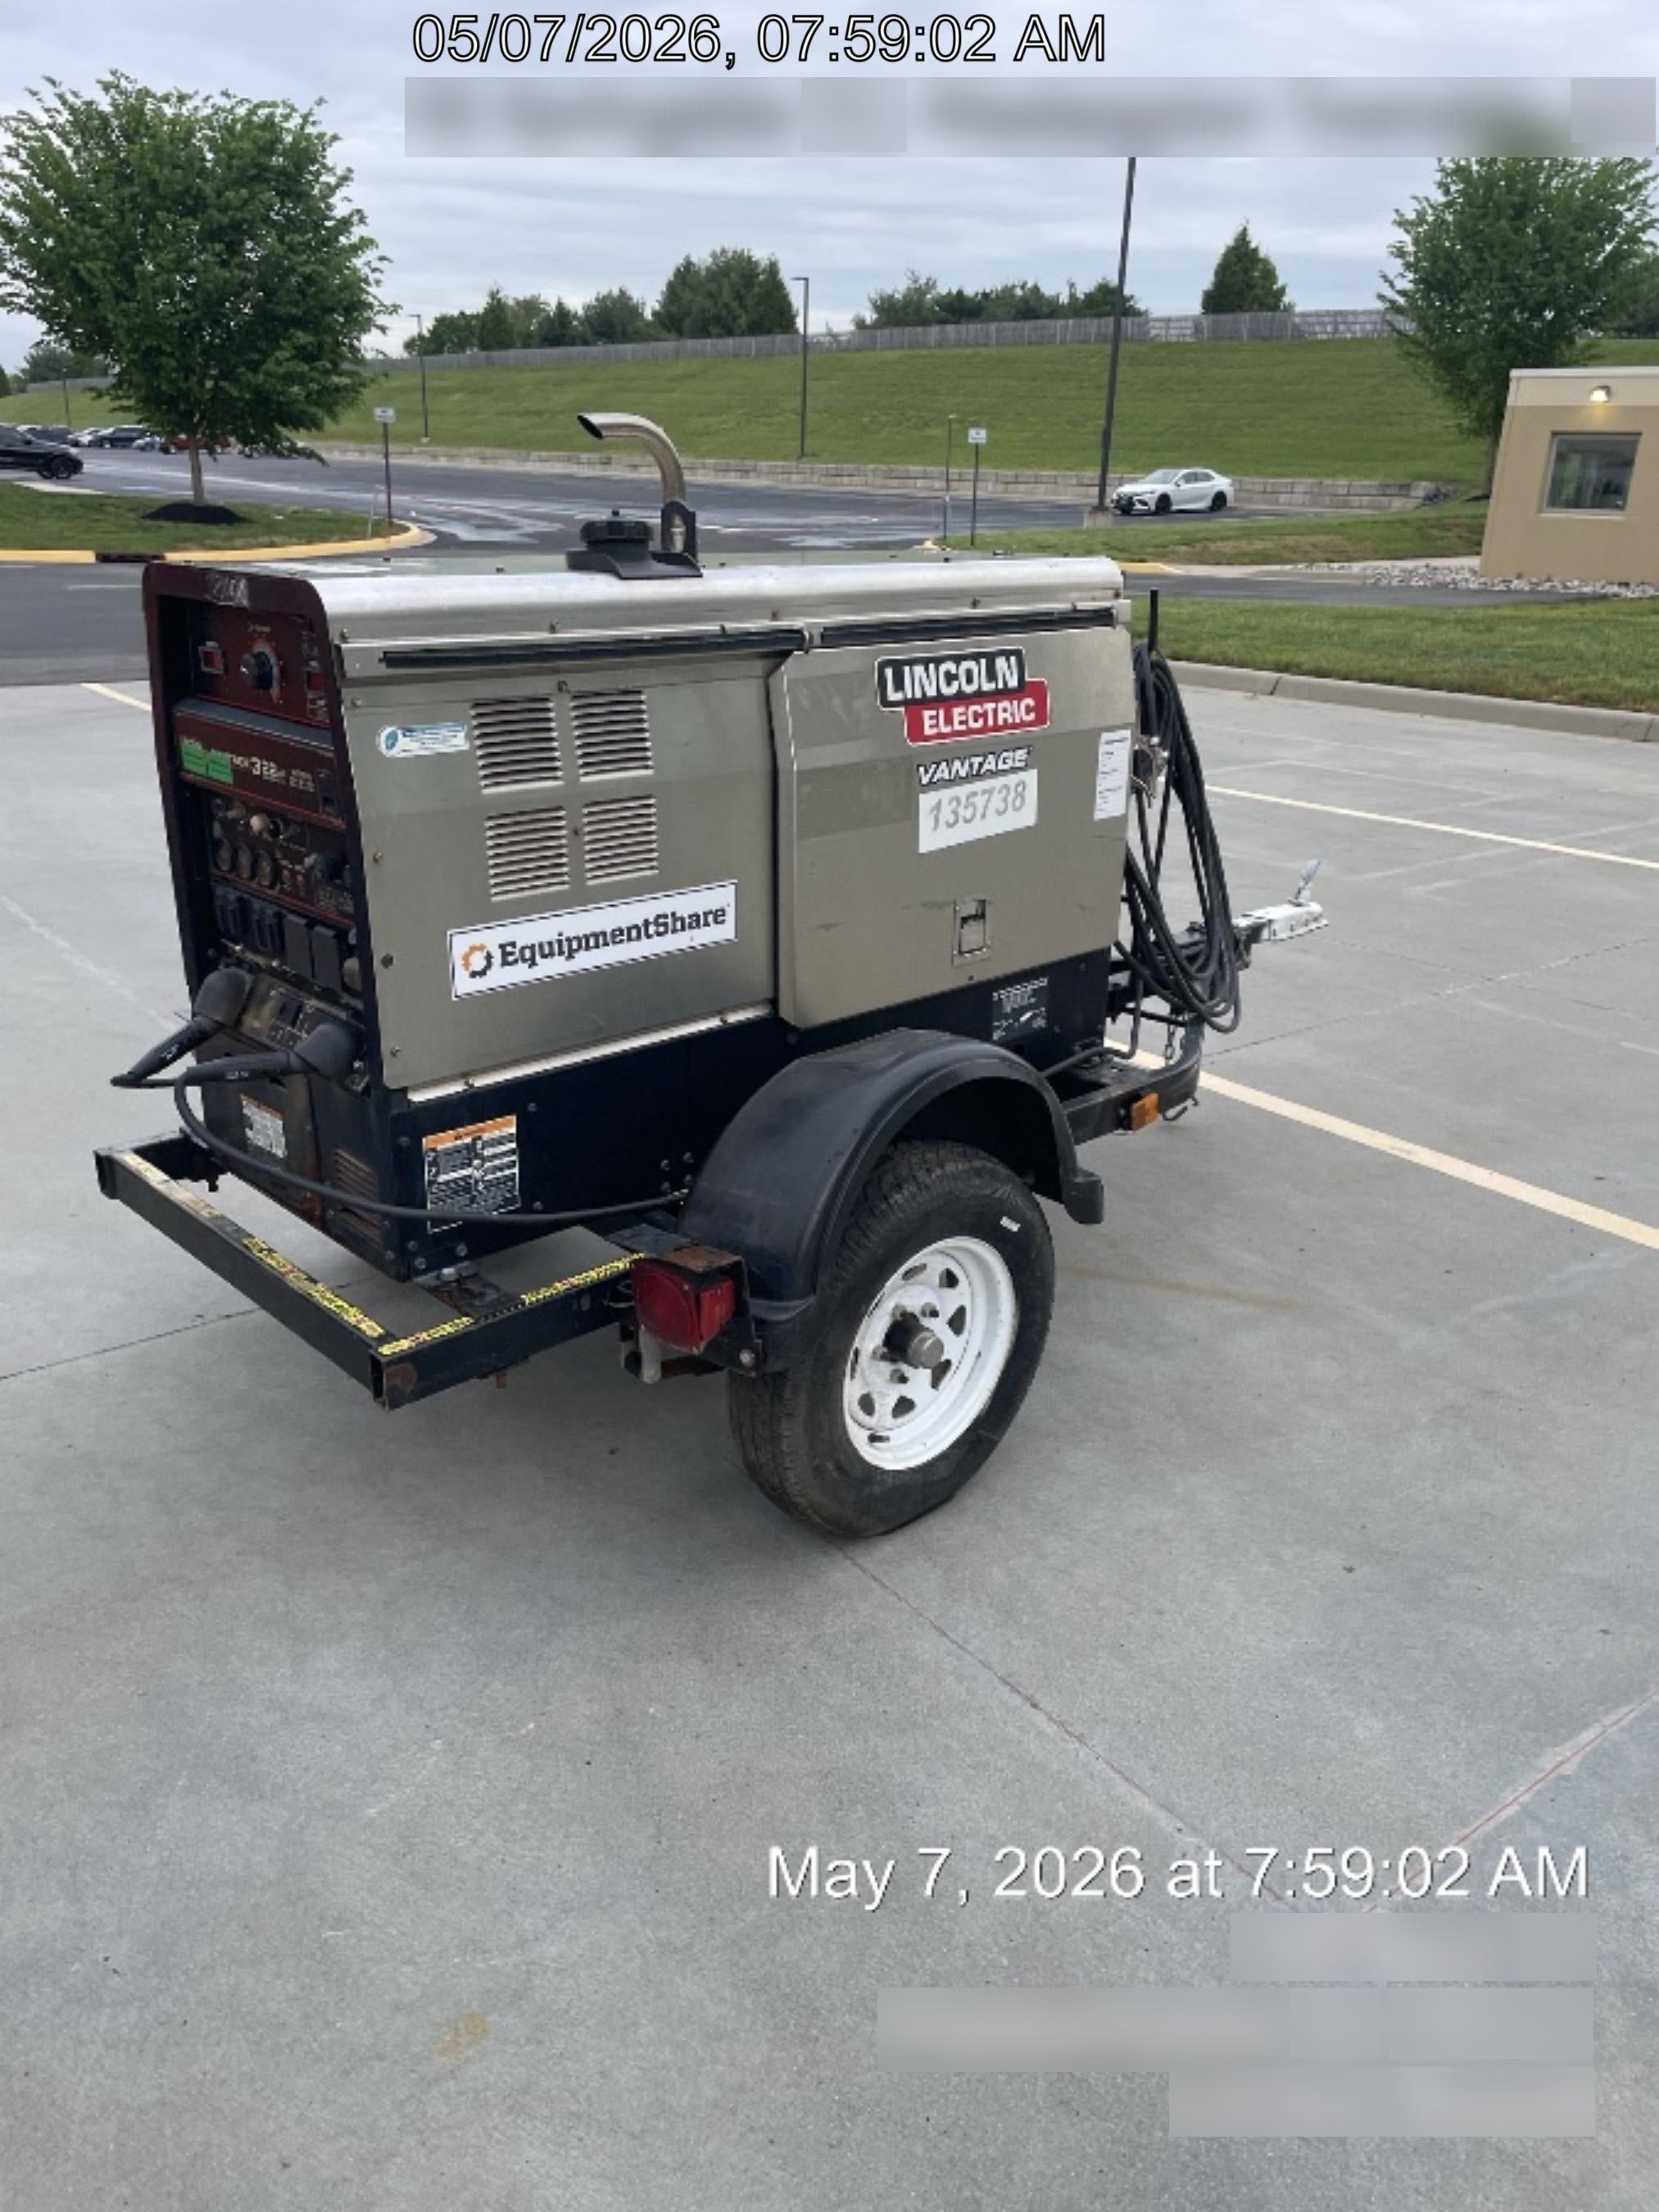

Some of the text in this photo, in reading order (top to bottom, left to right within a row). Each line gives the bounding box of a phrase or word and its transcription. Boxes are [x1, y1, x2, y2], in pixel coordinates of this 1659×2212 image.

[884, 655, 1019, 702] LINCOLN
[922, 697, 1036, 736] ELECTRIC
[918, 746, 1030, 786] VANTAGE
[929, 779, 1027, 832] 135738
[497, 906, 728, 969] EquipmentShare
